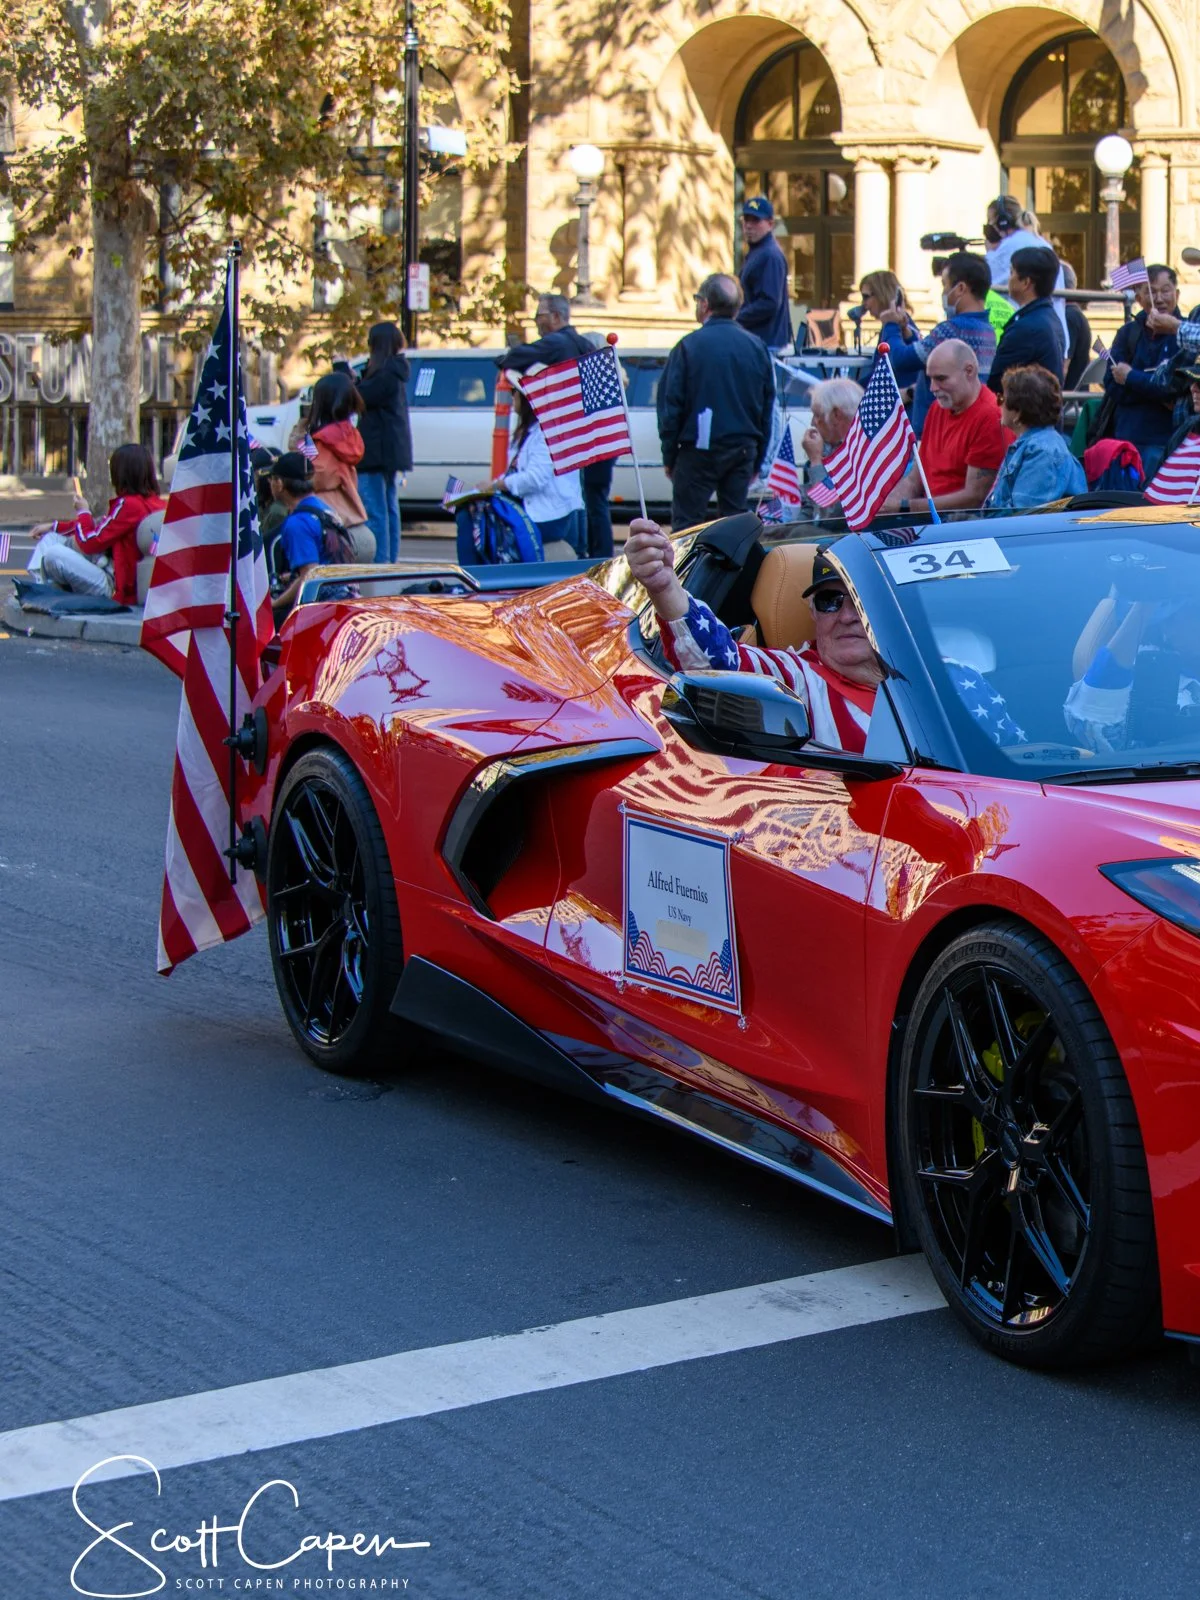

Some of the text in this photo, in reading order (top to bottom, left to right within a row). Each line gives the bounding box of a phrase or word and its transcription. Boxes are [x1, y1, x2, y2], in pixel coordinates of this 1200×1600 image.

[908, 549, 976, 575] 34
[647, 870, 709, 905] Alfred Fuerniss
[667, 905, 693, 928] US Navy
[954, 942, 1004, 961] MICHELIN
